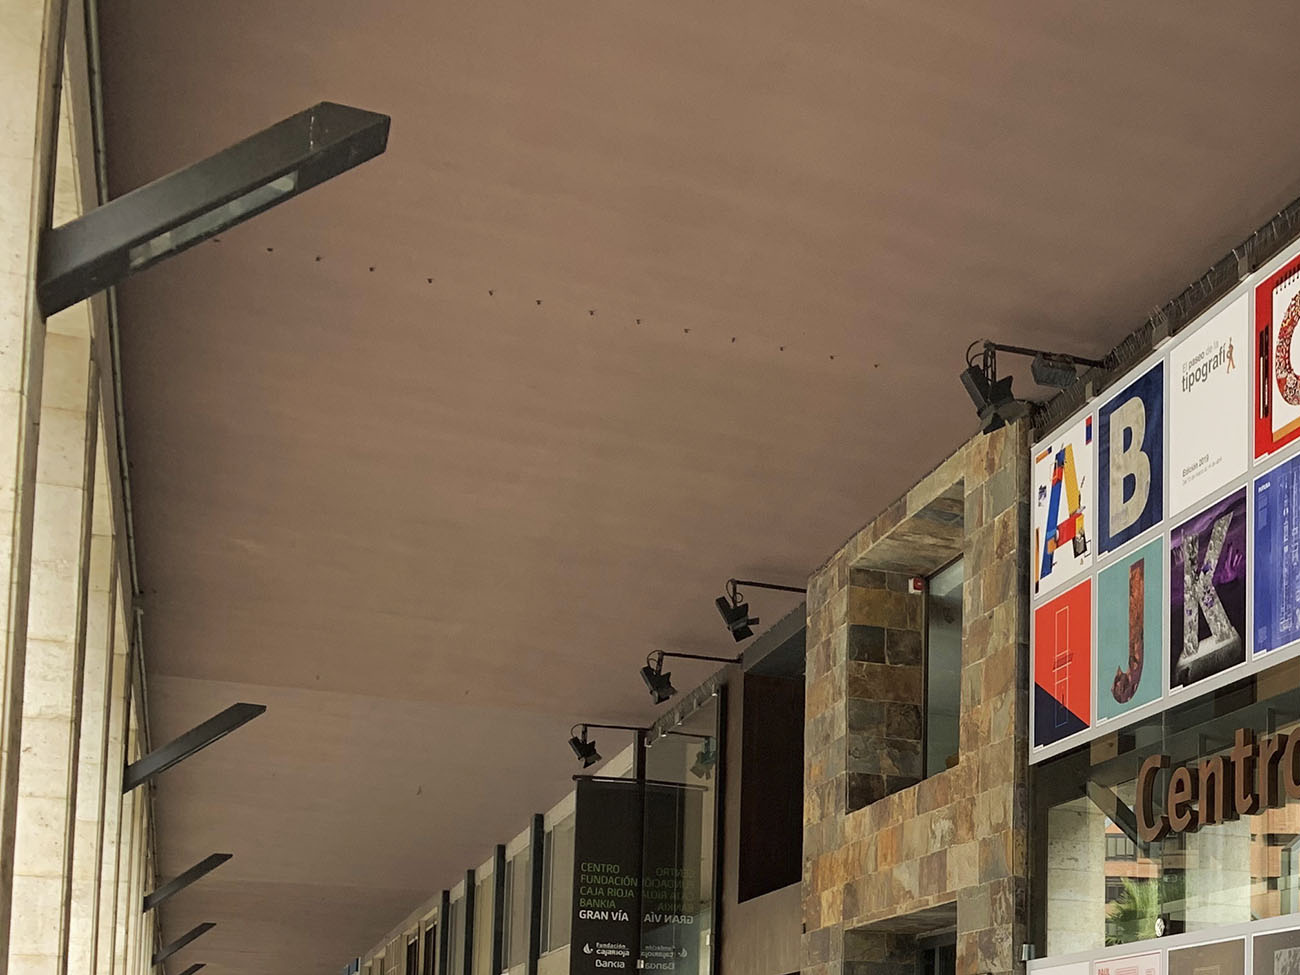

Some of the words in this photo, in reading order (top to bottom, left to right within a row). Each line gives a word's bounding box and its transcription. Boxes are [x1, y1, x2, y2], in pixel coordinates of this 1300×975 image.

[1109, 396, 1151, 539] B
[1111, 557, 1145, 704] J
[581, 862, 620, 874] CENTRO
[580, 873, 638, 887] FUNDACIÓN
[579, 886, 605, 897] CAJA
[607, 887, 635, 899] RIOJA
[579, 898, 616, 909] BANKIA
[579, 909, 609, 921] GRAN
[610, 909, 629, 922] VÍA
[595, 959, 625, 969] Bankia
